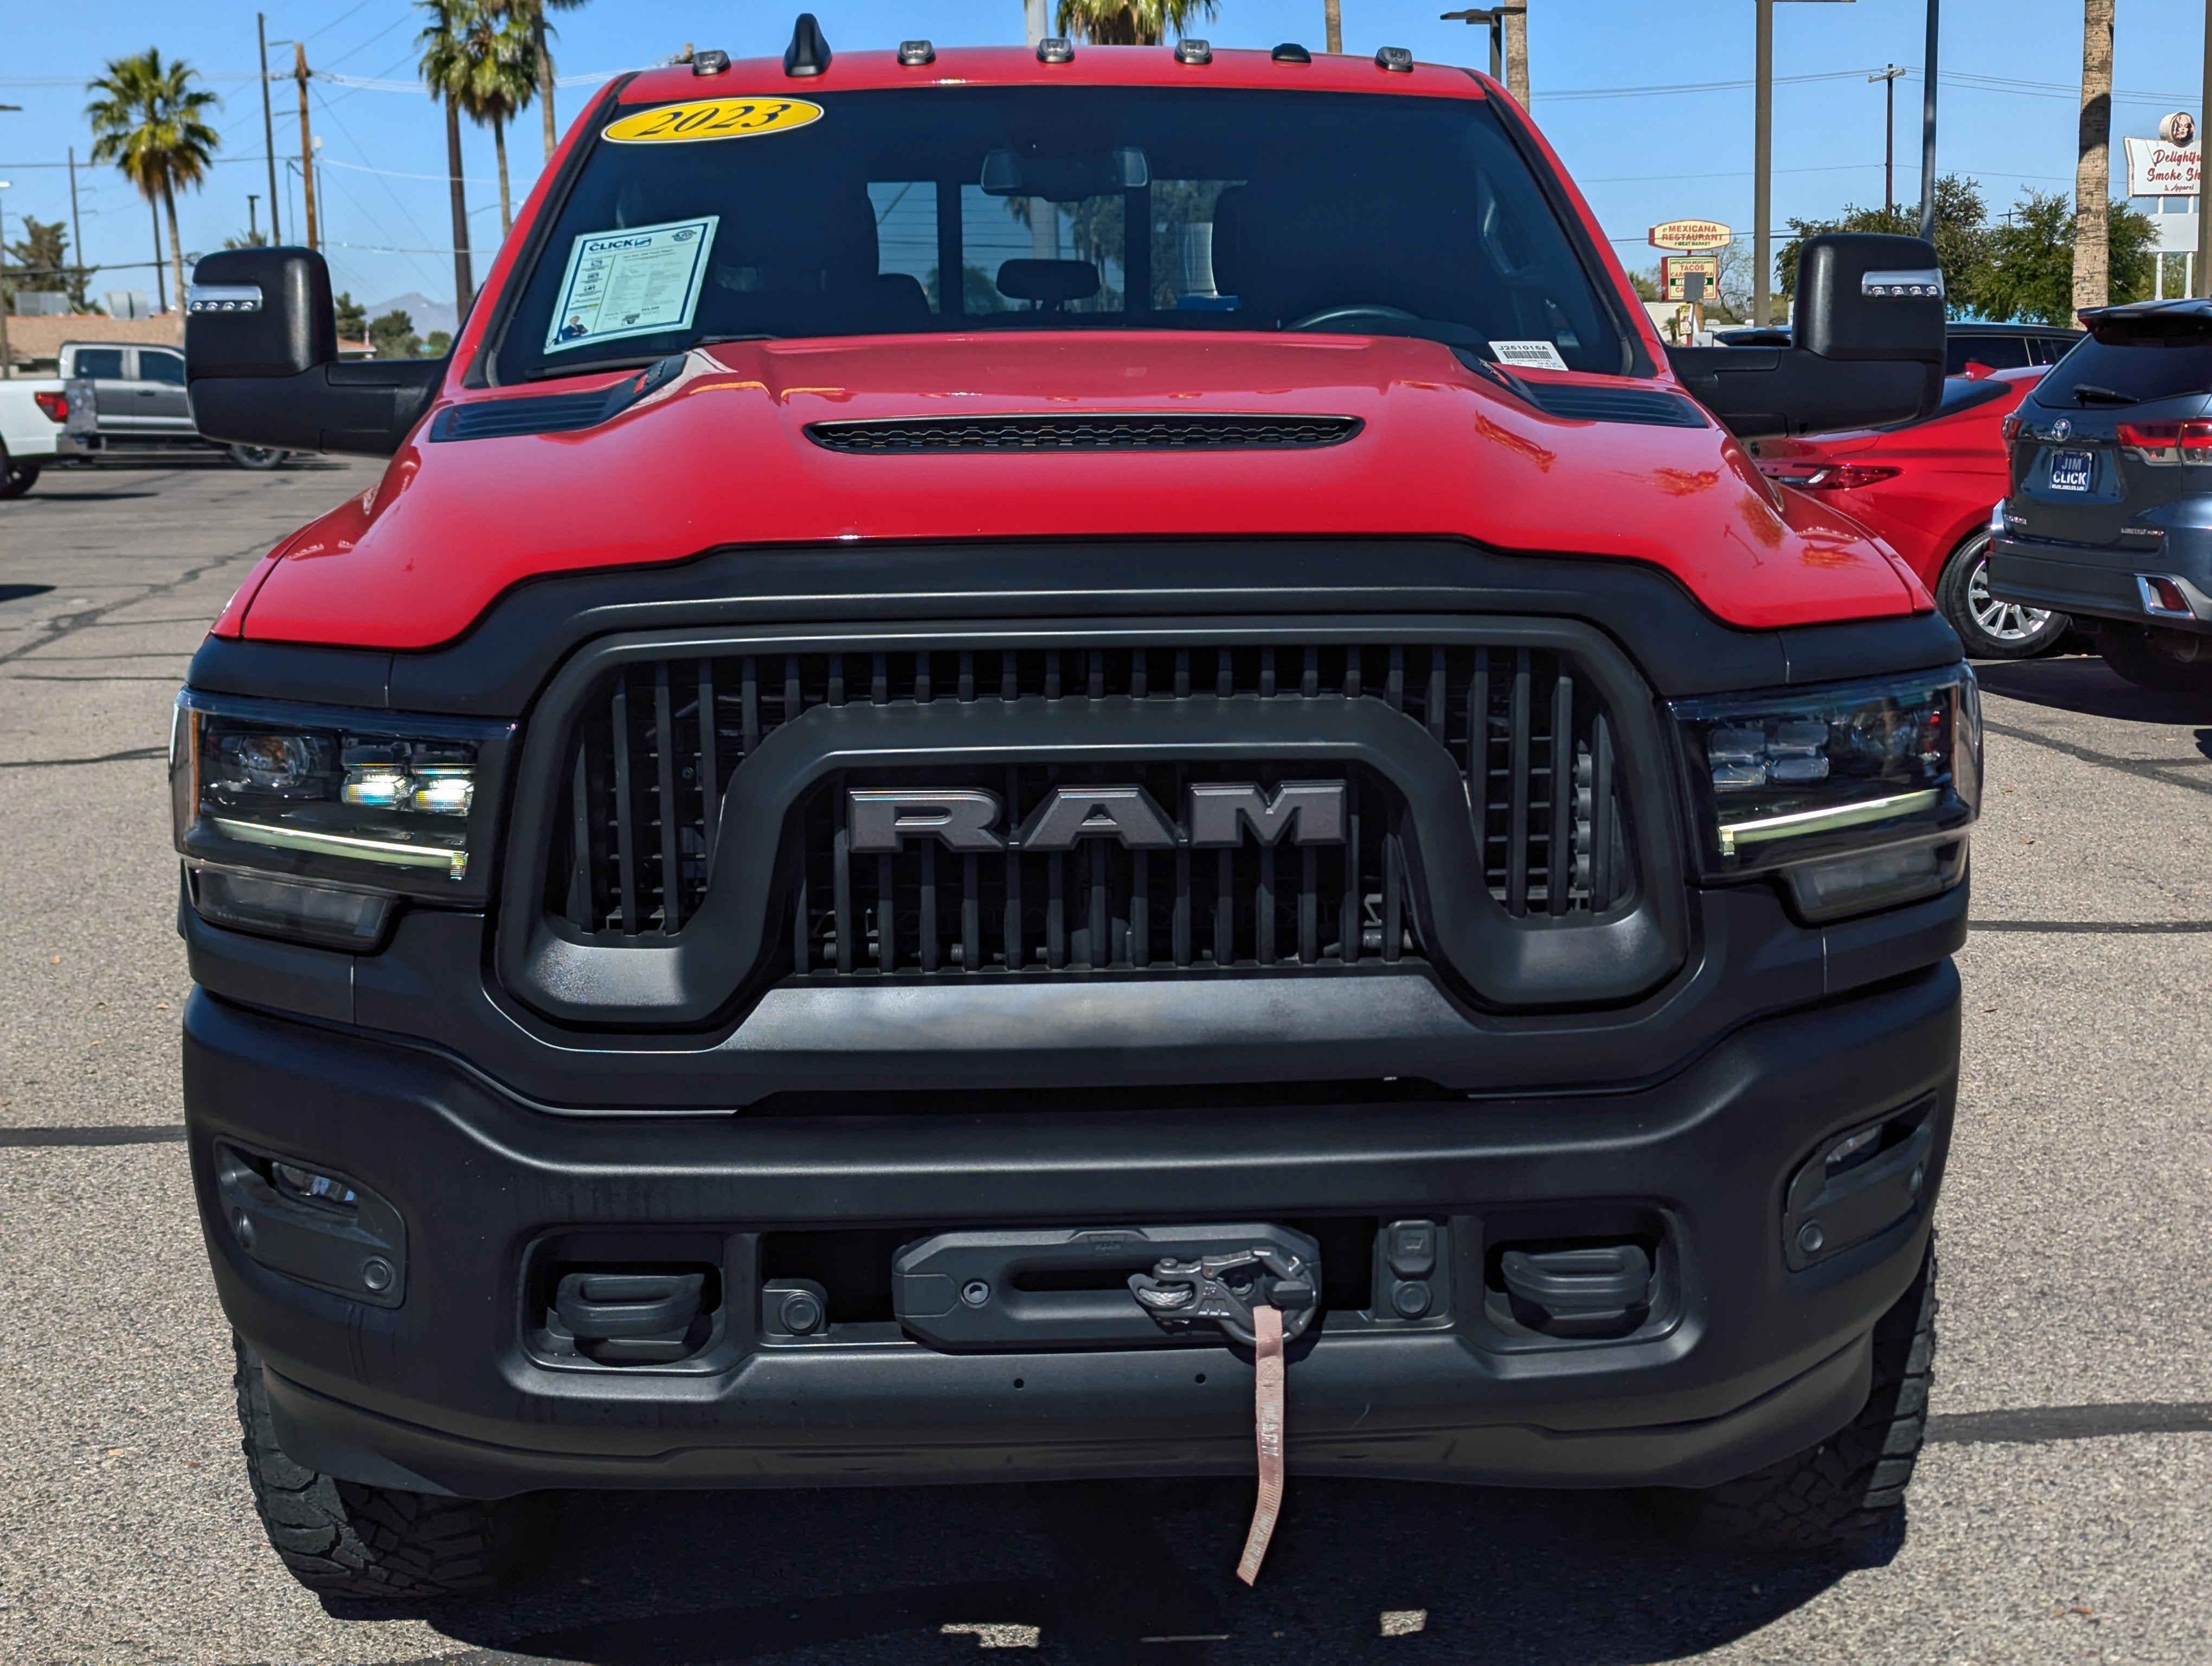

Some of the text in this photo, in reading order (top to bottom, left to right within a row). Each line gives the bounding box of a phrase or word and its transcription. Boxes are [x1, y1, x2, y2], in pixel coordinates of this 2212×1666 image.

[633, 103, 792, 137] 2023
[2153, 149, 2201, 166] Delightfu
[2147, 167, 2201, 182] Smoke Sh
[2171, 183, 2194, 192] Apparel
[589, 239, 634, 251] CLICK
[2061, 457, 2082, 471] JIM
[2053, 470, 2087, 485] CLICK
[846, 779, 1347, 854] RAM
